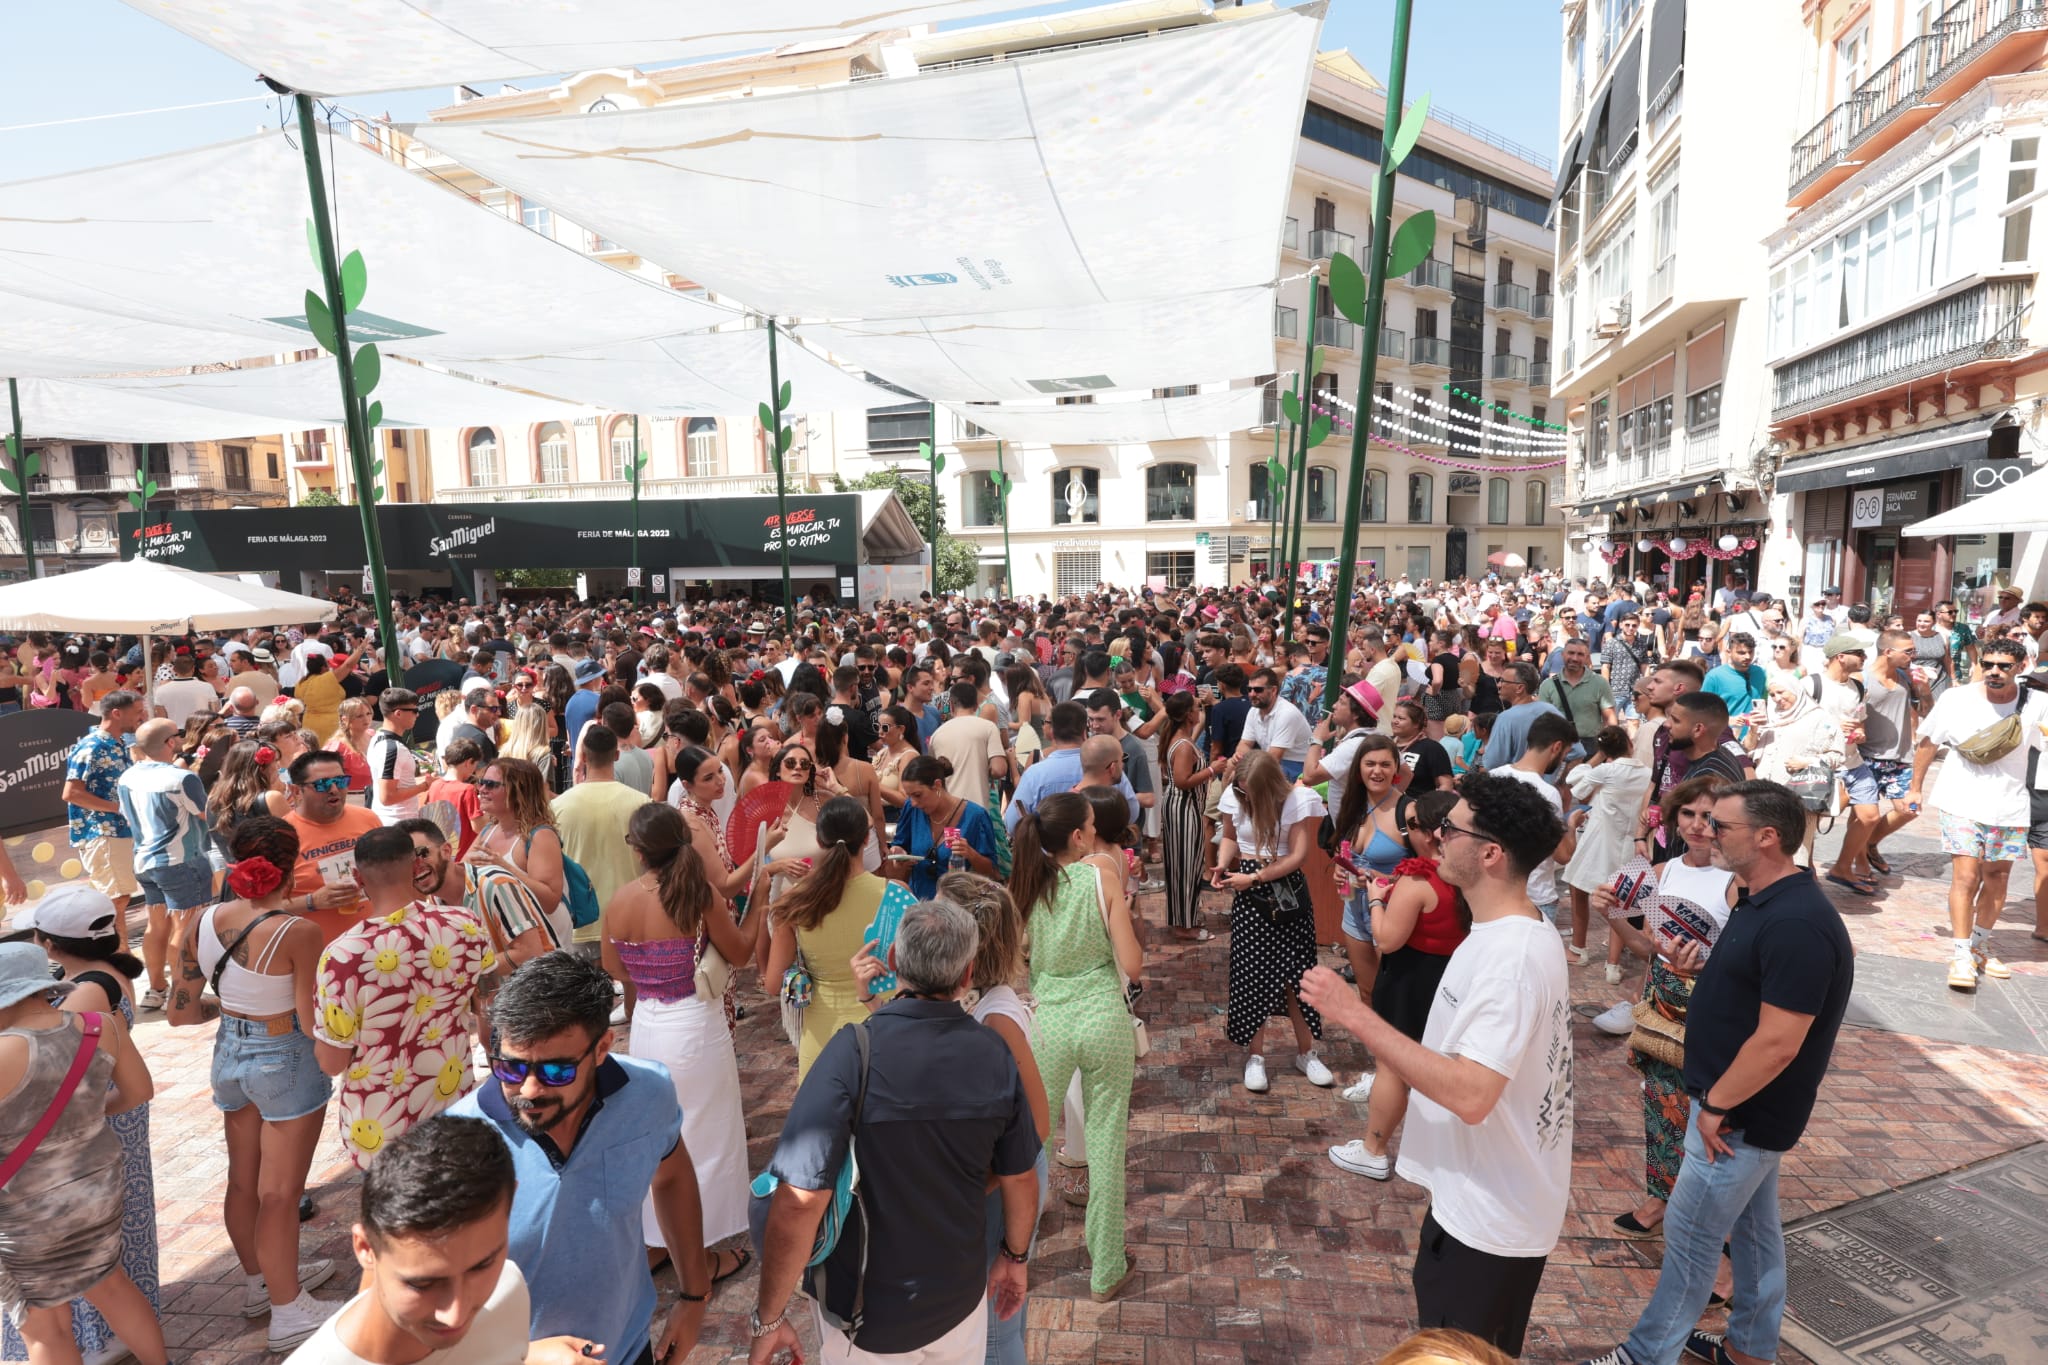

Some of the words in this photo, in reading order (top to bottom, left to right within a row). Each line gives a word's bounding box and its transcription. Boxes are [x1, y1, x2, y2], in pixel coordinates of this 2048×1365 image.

[1886, 490, 1917, 501] FERNÁNDEZ
[1886, 502, 1901, 512] BACA
[764, 509, 816, 526] ATRVERSE
[786, 520, 825, 535] MARCAR
[827, 517, 840, 529] TU
[181, 530, 192, 541] TU
[247, 535, 268, 544] FERIA
[268, 535, 279, 543] DE
[279, 533, 308, 543] MÁLAGA
[309, 534, 327, 542] 2023
[577, 530, 601, 539] FERIA
[602, 530, 613, 538] DE
[650, 529, 670, 537] 2023
[799, 533, 831, 547] RITMO
[1818, 1225, 1917, 1280] PENDIENTES
[1922, 1282, 1952, 1298] DE
[1836, 1246, 1898, 1283] ESPAÑA
